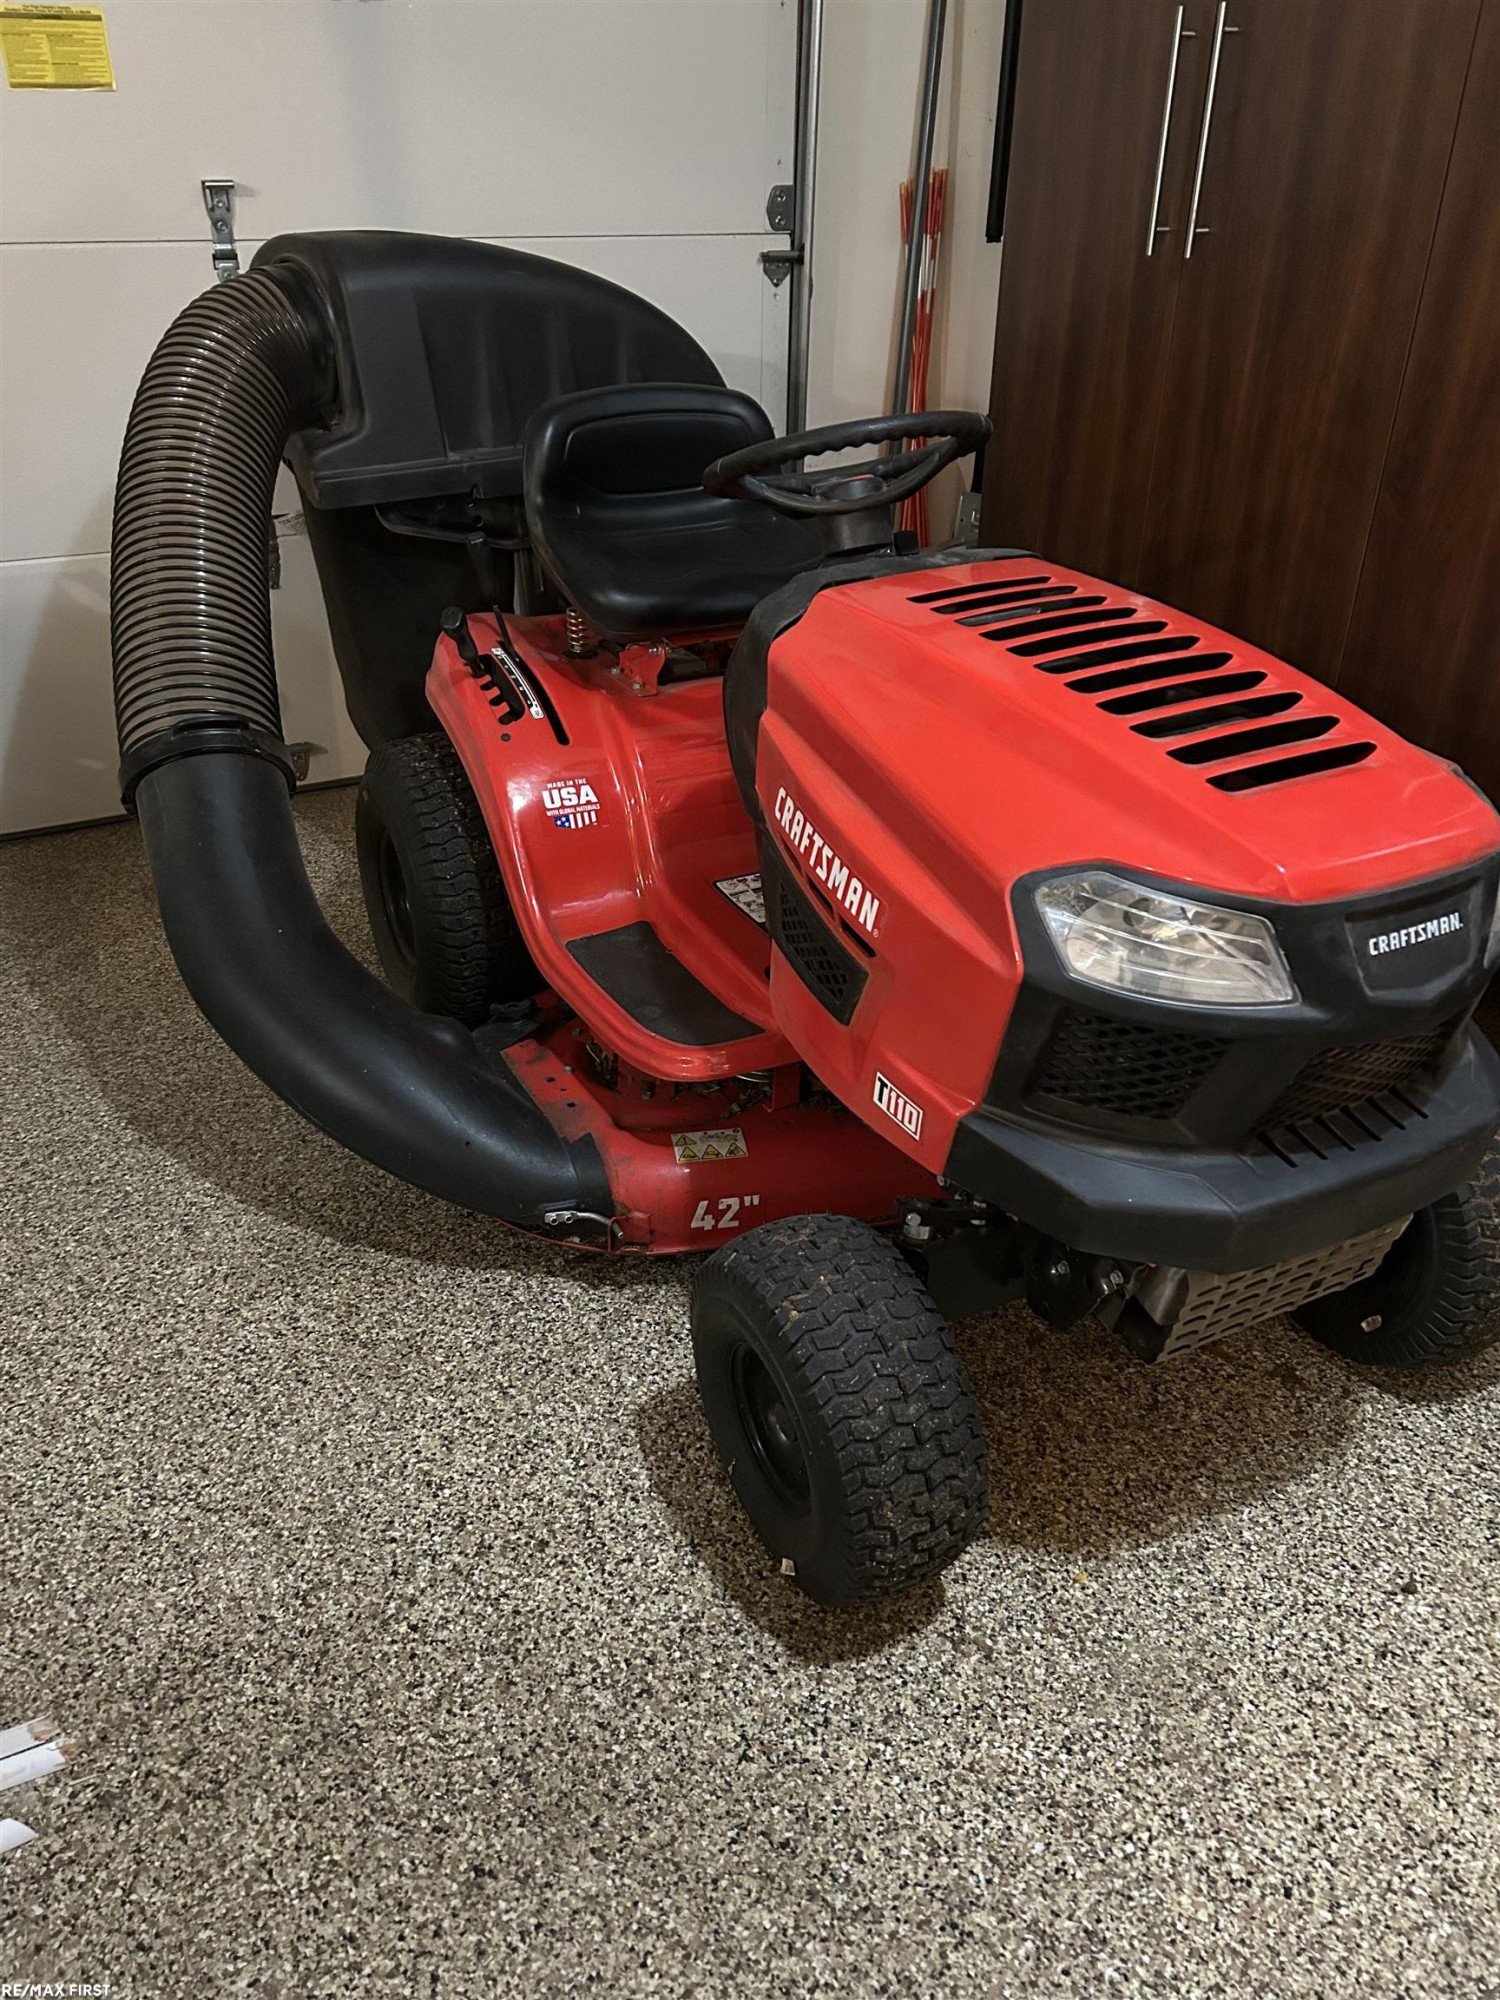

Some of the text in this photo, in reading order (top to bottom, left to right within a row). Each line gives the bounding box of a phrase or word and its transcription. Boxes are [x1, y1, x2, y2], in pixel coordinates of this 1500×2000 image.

[541, 784, 599, 809] USA
[775, 787, 880, 932] CRAFTSMAN
[1368, 912, 1461, 956] CRAFTSMAN
[877, 1076, 919, 1133] T110
[690, 1194, 760, 1231] 42"
